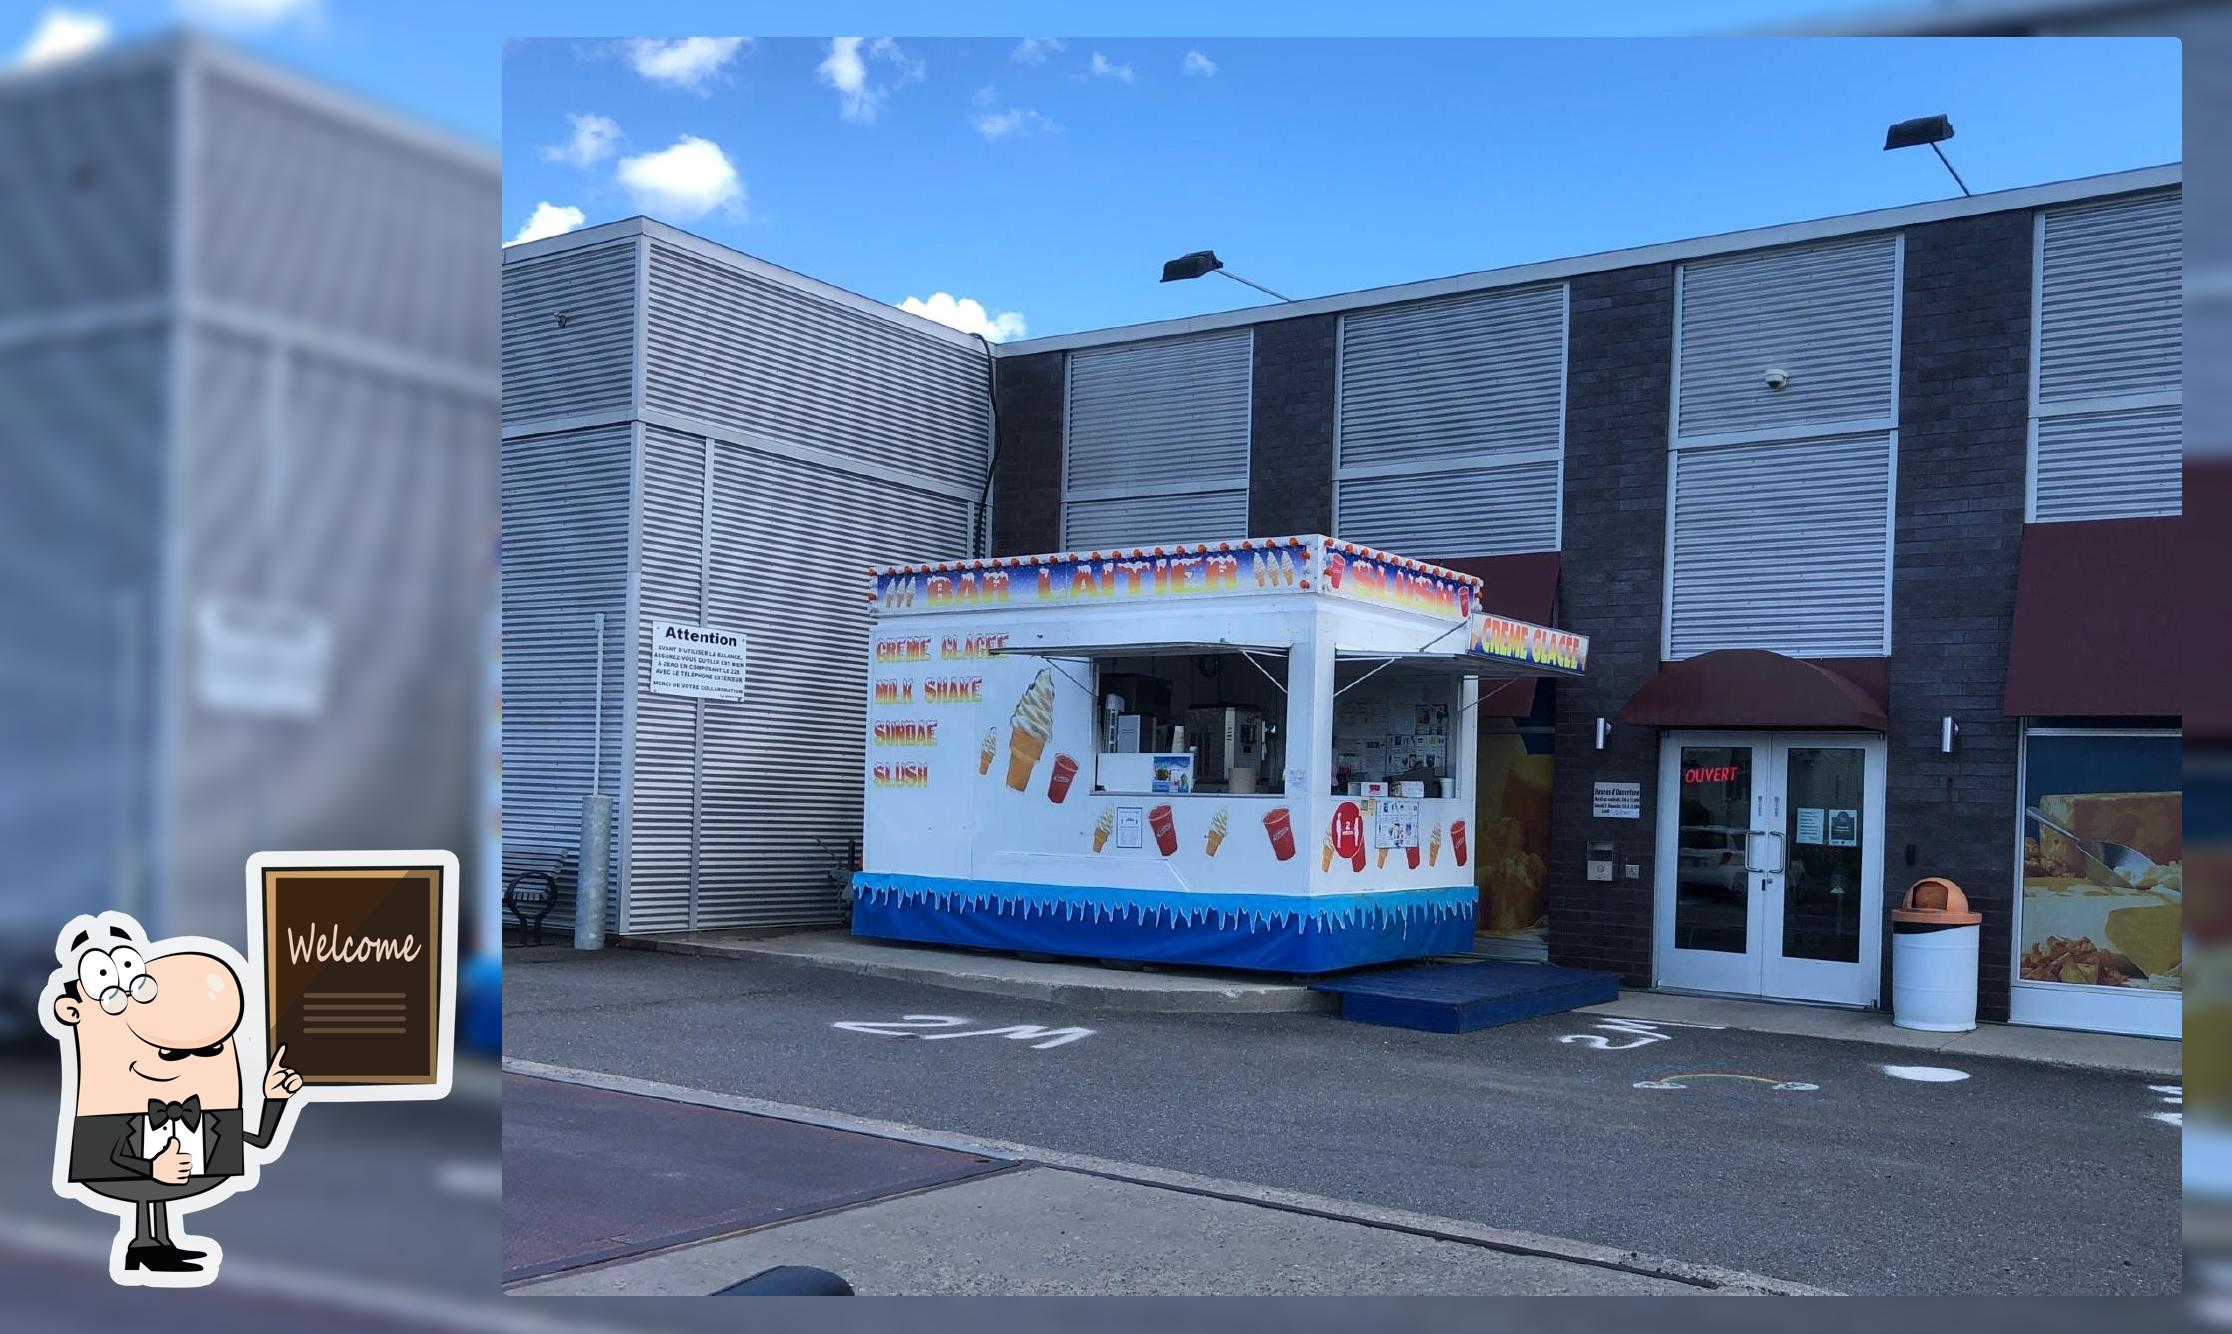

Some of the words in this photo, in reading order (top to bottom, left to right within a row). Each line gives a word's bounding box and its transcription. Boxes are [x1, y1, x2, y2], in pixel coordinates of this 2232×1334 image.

[926, 571, 1008, 606] BAR
[1036, 554, 1237, 601] LAITIER
[665, 626, 737, 647] Attention
[875, 678, 913, 704] MILK
[923, 676, 983, 703] SHAKE
[874, 719, 938, 746] SUNDAE
[873, 761, 929, 788] SLUSH
[1685, 766, 1738, 784] OUVERT
